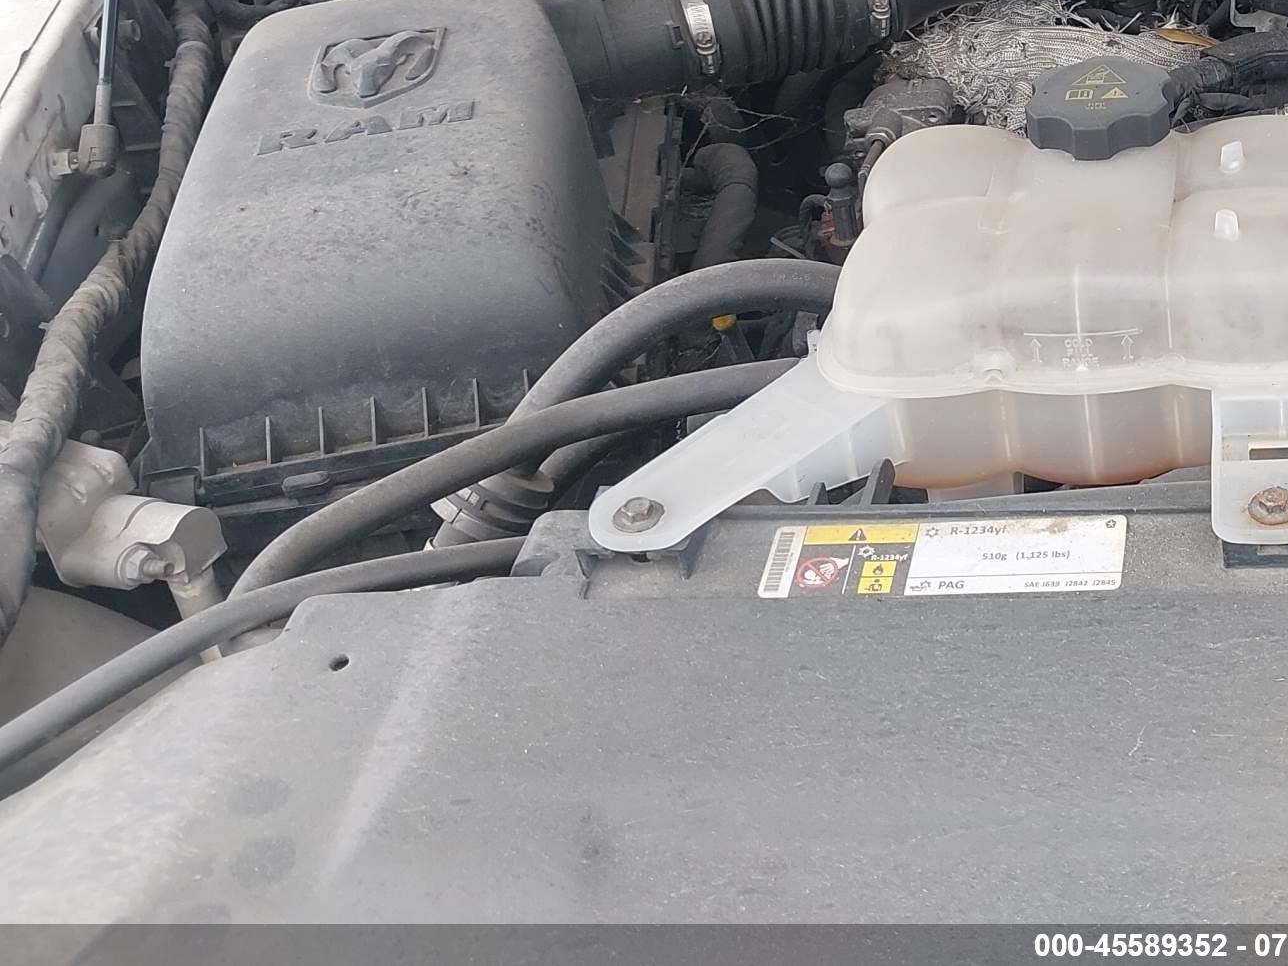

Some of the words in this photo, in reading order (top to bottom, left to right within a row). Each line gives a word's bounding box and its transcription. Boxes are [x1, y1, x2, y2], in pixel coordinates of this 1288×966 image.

[256, 101, 476, 155] RAM
[950, 524, 1007, 536] R-1234yf
[982, 552, 1008, 561] 510g
[1051, 550, 1071, 560] lbs)
[938, 580, 965, 590] PAG
